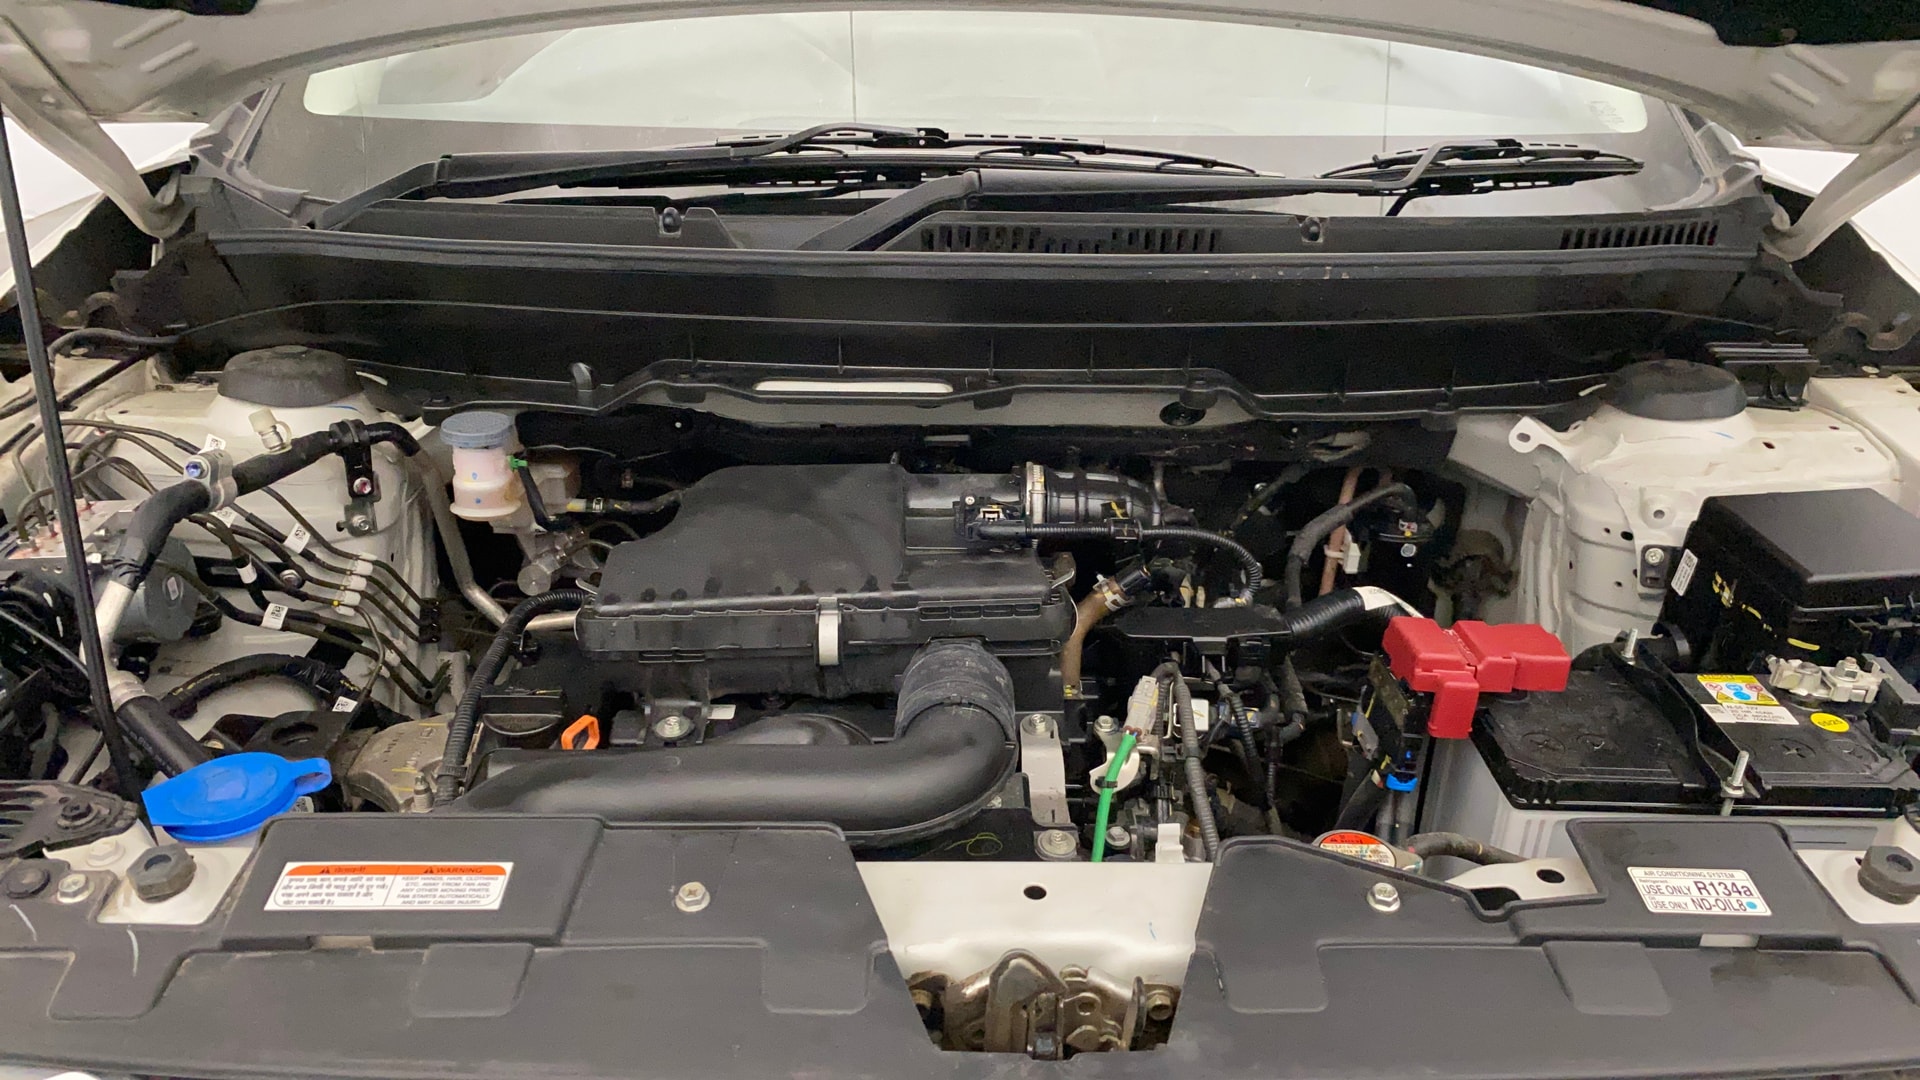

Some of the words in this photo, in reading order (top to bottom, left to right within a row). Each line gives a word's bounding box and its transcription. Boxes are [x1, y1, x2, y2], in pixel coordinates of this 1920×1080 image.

[1642, 884, 1665, 895] USE
[1665, 885, 1692, 896] ONLY
[1693, 880, 1754, 897] R134a
[1651, 901, 1669, 910] USE
[1669, 901, 1690, 910] ONLY
[1690, 897, 1748, 912] ND-OIL8
